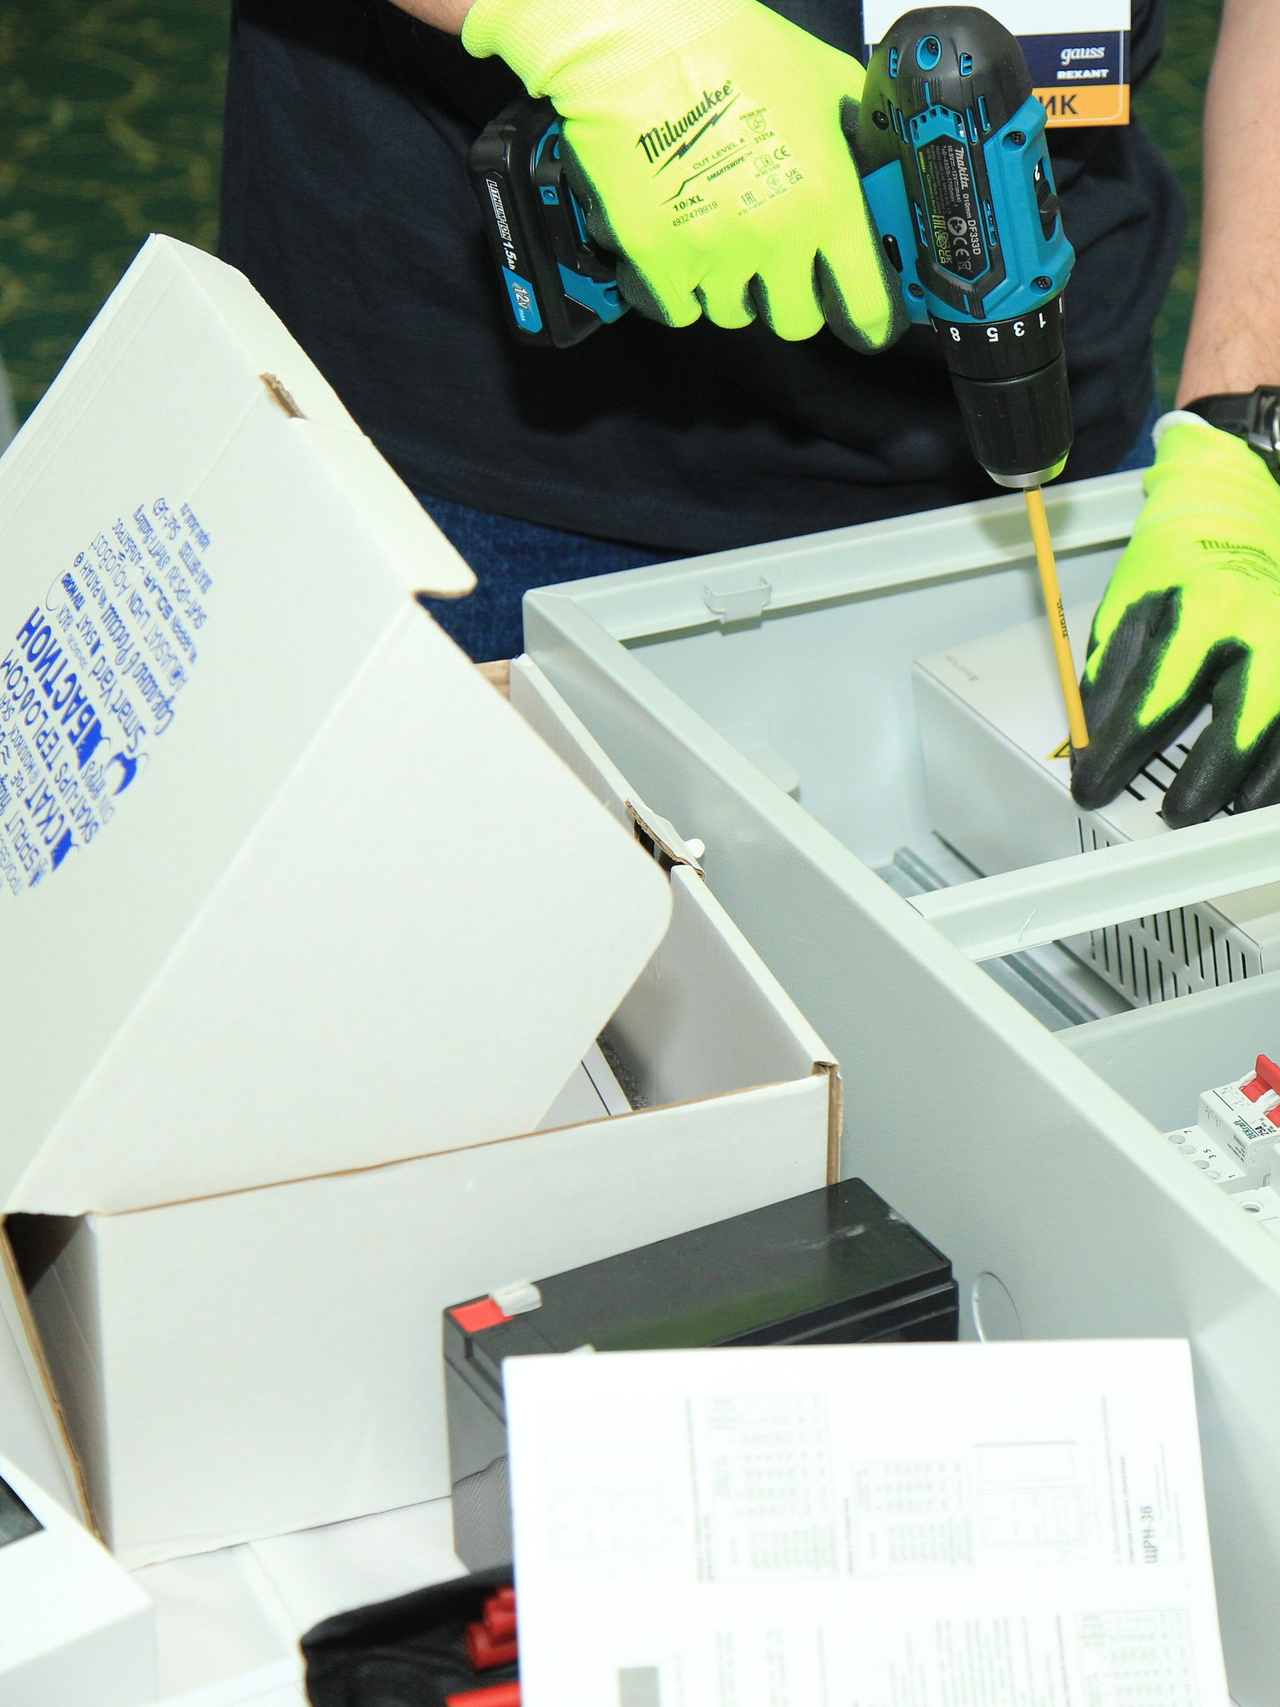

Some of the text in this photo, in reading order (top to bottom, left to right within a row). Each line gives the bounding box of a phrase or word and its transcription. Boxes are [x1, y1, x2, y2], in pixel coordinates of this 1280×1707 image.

[1060, 46, 1106, 66] gauss
[1056, 69, 1109, 80] REXANT
[635, 83, 733, 164] Milwaukee
[754, 131, 775, 144] 3121A
[692, 157, 711, 170] CUT
[712, 142, 738, 160] LEVEL
[672, 201, 718, 227] 4932479919
[673, 194, 705, 212] 10/XL
[967, 219, 981, 255] DF333D
[950, 327, 960, 342] 8
[986, 327, 998, 342] 5
[1013, 321, 1025, 337] 3
[143, 571, 173, 620] SOLAR
[76, 613, 97, 646] SKAT
[17, 605, 97, 749] БАСТИОН
[88, 655, 146, 753] Smart Yard
[132, 662, 175, 735] Сделано
[24, 776, 65, 846] СКАТ
[53, 761, 99, 844] SKAT-UPS
[4, 810, 40, 873] SPRUT
[1233, 1119, 1257, 1140] DEKraft
[1140, 1505, 1158, 1564] ЩРН-36
